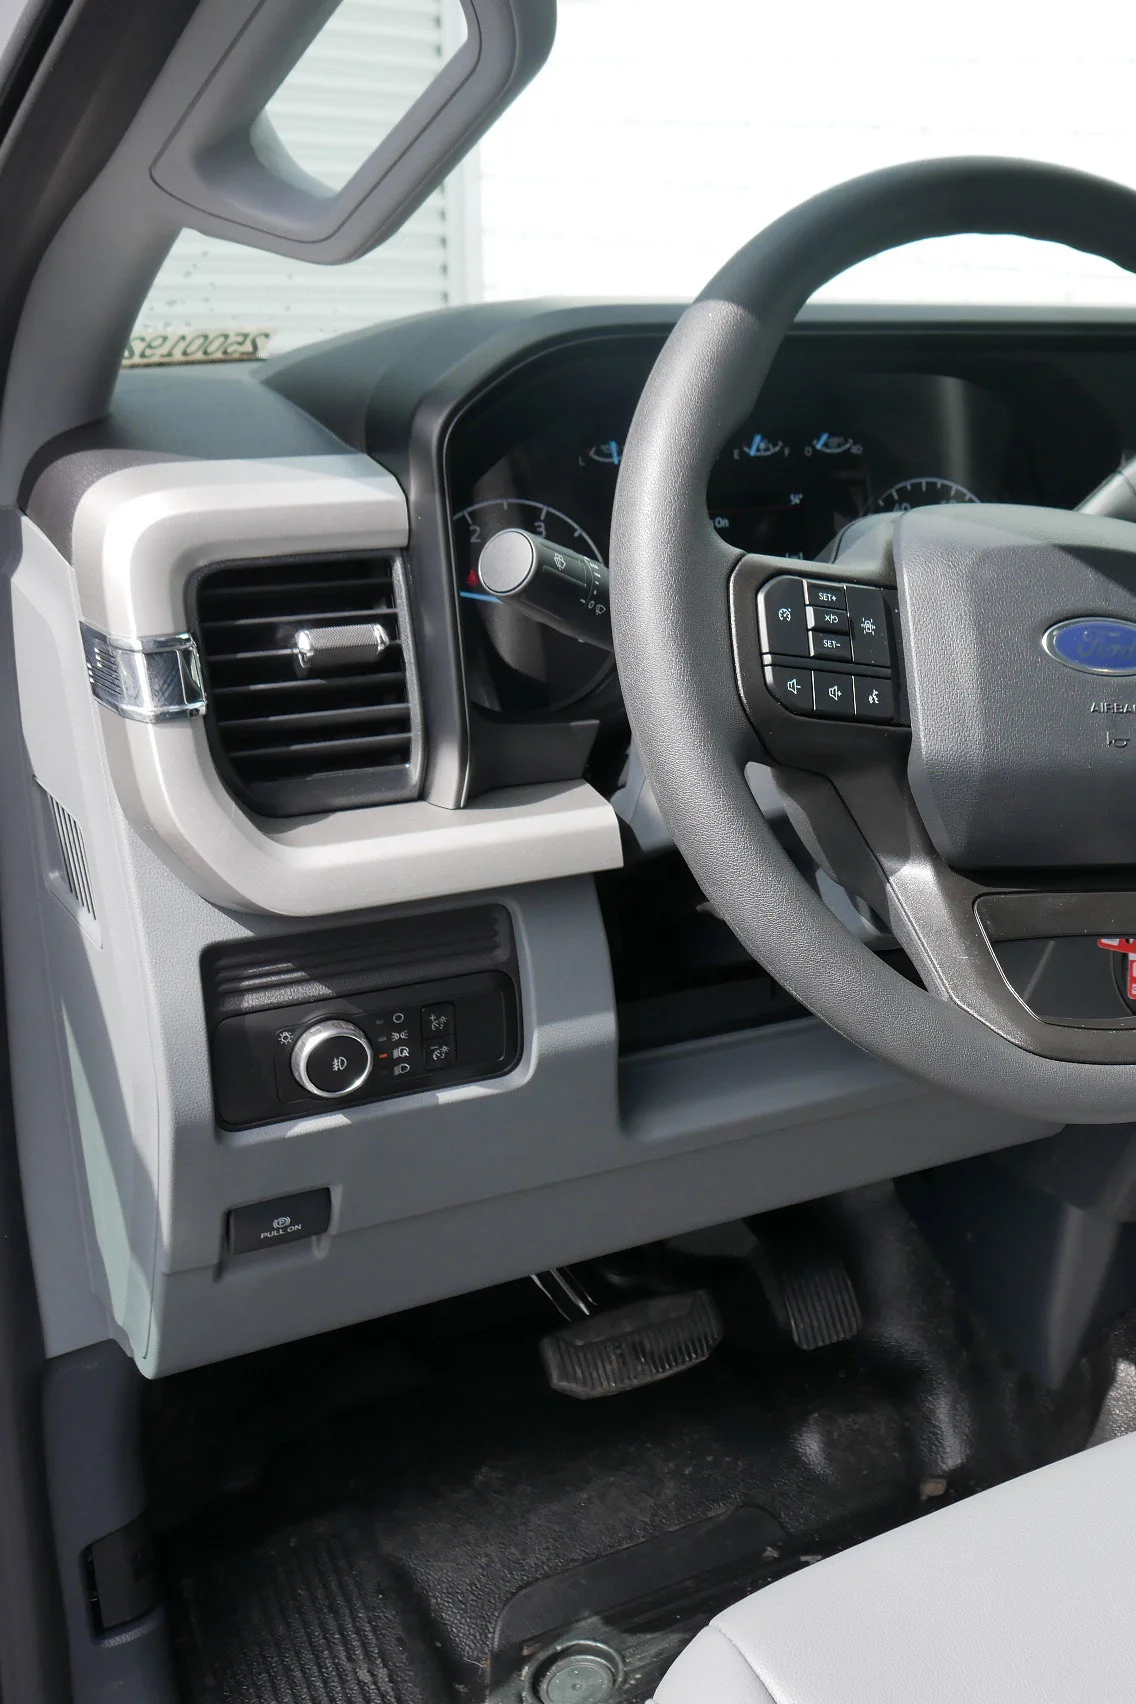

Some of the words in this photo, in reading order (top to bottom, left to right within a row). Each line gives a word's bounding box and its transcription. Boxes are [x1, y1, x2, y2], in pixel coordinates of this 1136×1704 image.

[469, 524, 482, 543] 2
[534, 520, 547, 539] 3
[260, 1227, 286, 1239] PULL
[287, 1223, 302, 1233] ON
